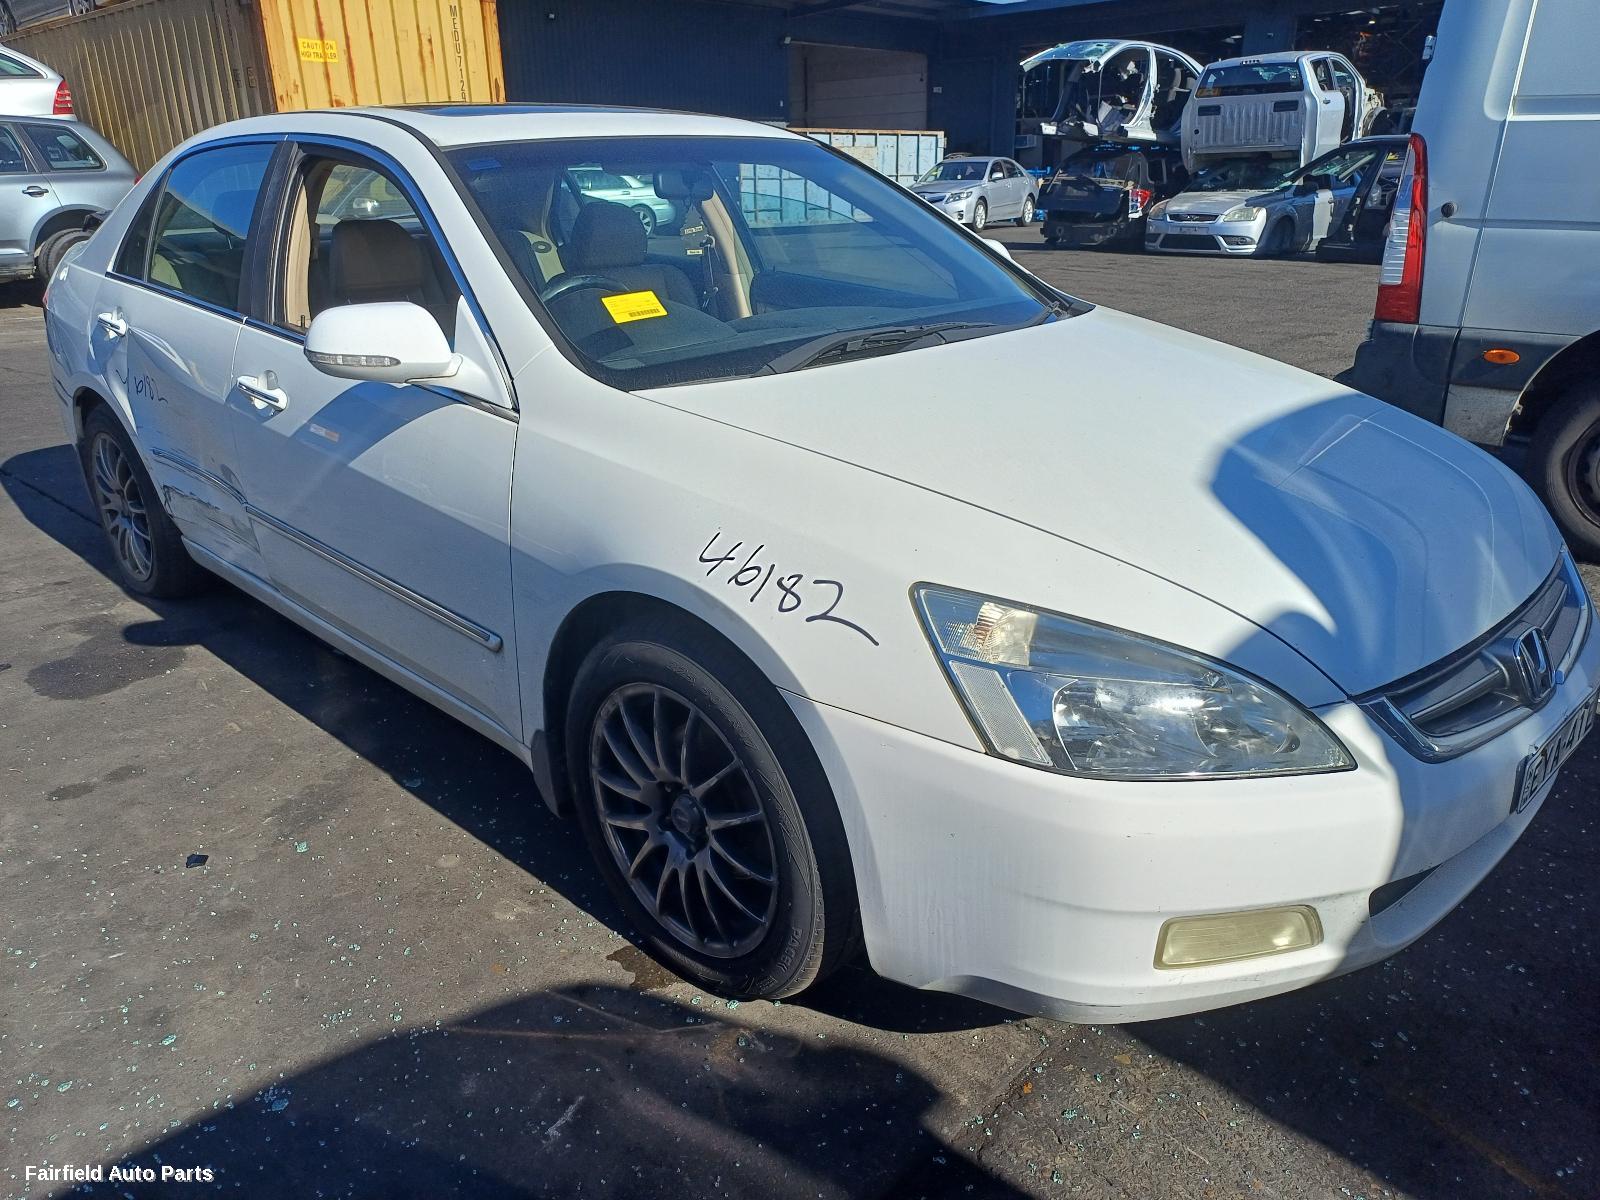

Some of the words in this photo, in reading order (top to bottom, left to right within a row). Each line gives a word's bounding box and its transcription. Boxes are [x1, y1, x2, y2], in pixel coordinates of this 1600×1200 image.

[302, 41, 334, 51] CAUTION
[312, 51, 337, 60] TRALER
[699, 531, 880, 647] 46182
